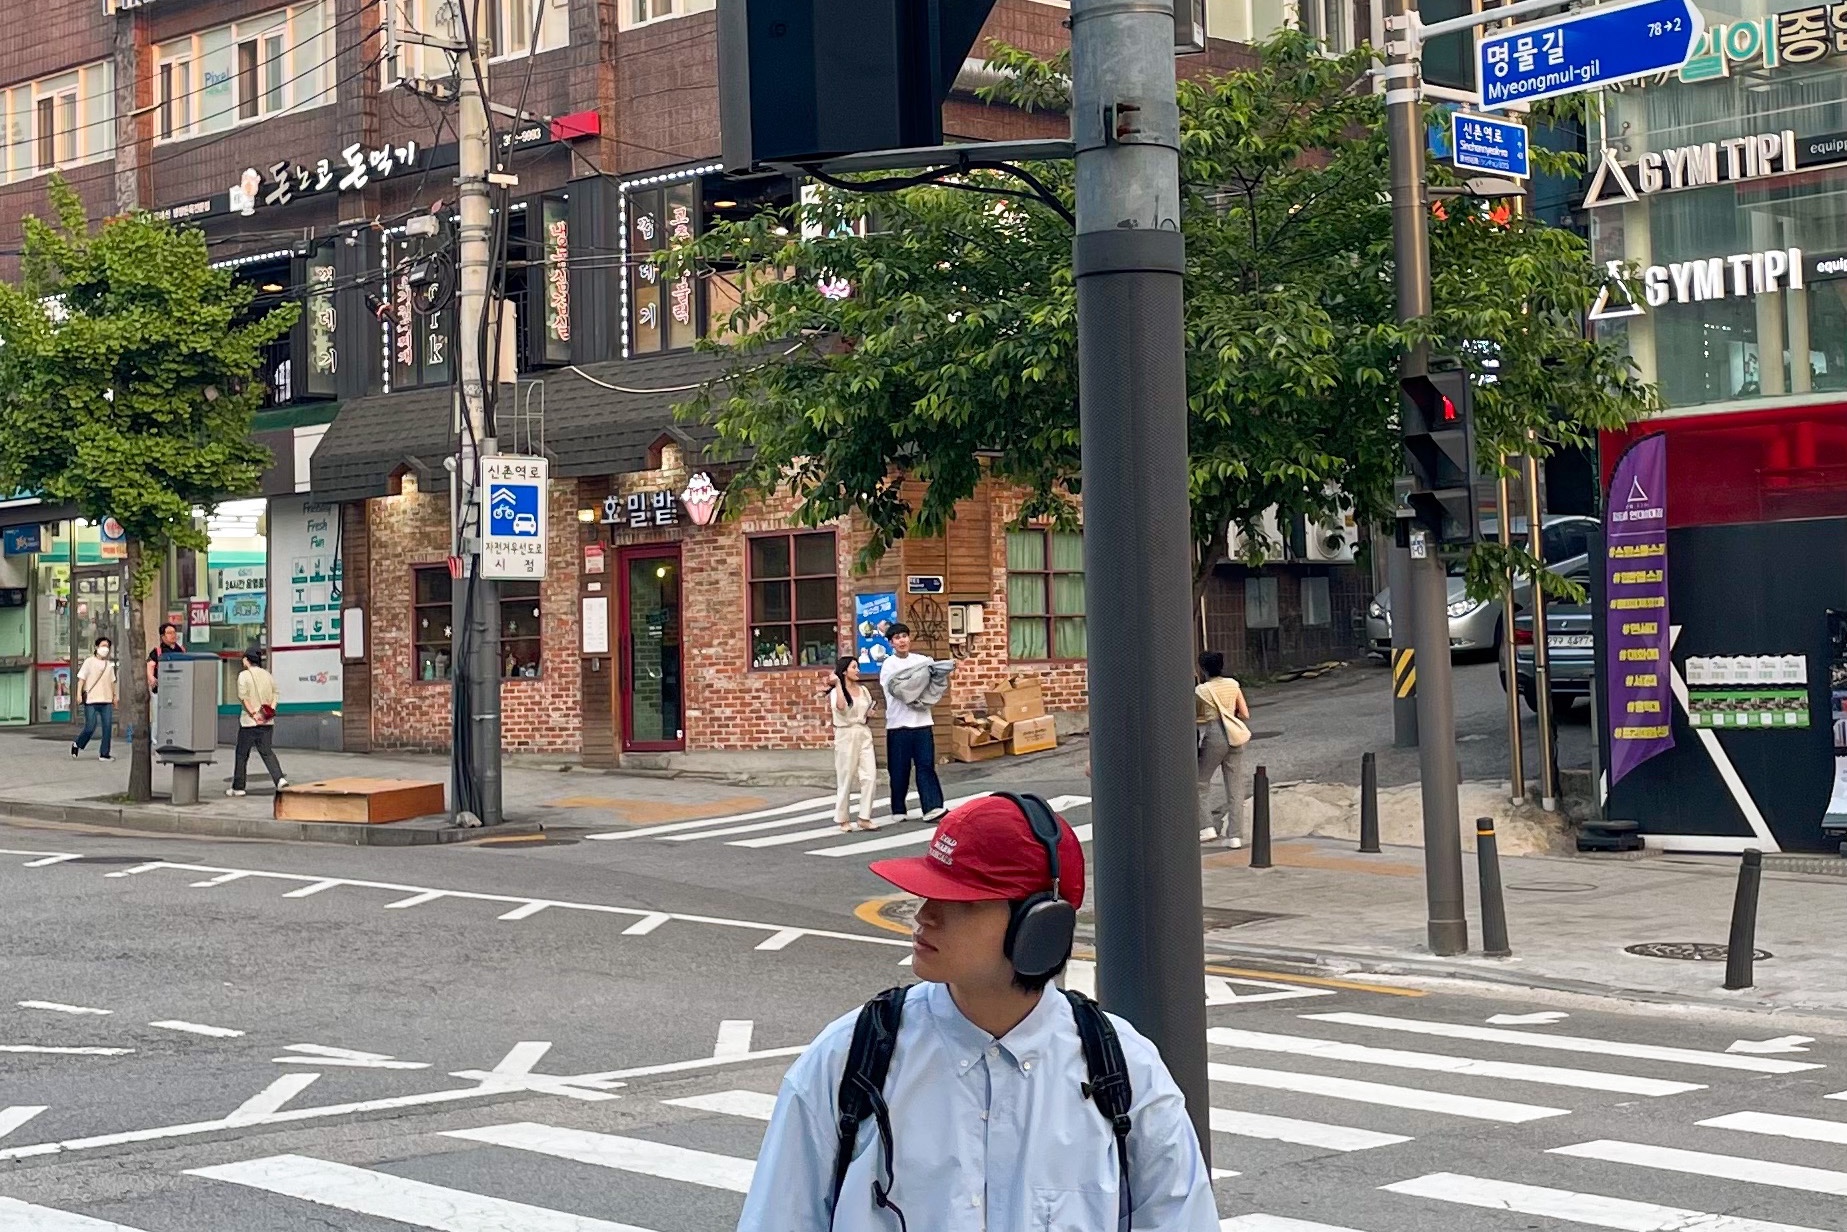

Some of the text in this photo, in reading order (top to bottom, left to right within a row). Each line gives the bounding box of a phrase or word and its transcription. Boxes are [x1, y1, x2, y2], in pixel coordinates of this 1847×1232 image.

[1486, 28, 1564, 78] 명물길
[1488, 59, 1600, 100] Myeongmul-gil
[1462, 122, 1504, 143] 신촌역로
[338, 140, 416, 191] 돈먹기
[1638, 129, 1797, 193] GYM TIPI
[1644, 247, 1803, 307] GYM TIPI
[487, 464, 541, 480] 신촌역로
[600, 489, 679, 529] 호밀밭
[307, 518, 328, 533] Fresh
[310, 535, 325, 549] Fun
[485, 541, 543, 556] 자전거우선도로
[191, 611, 208, 625] SIM
